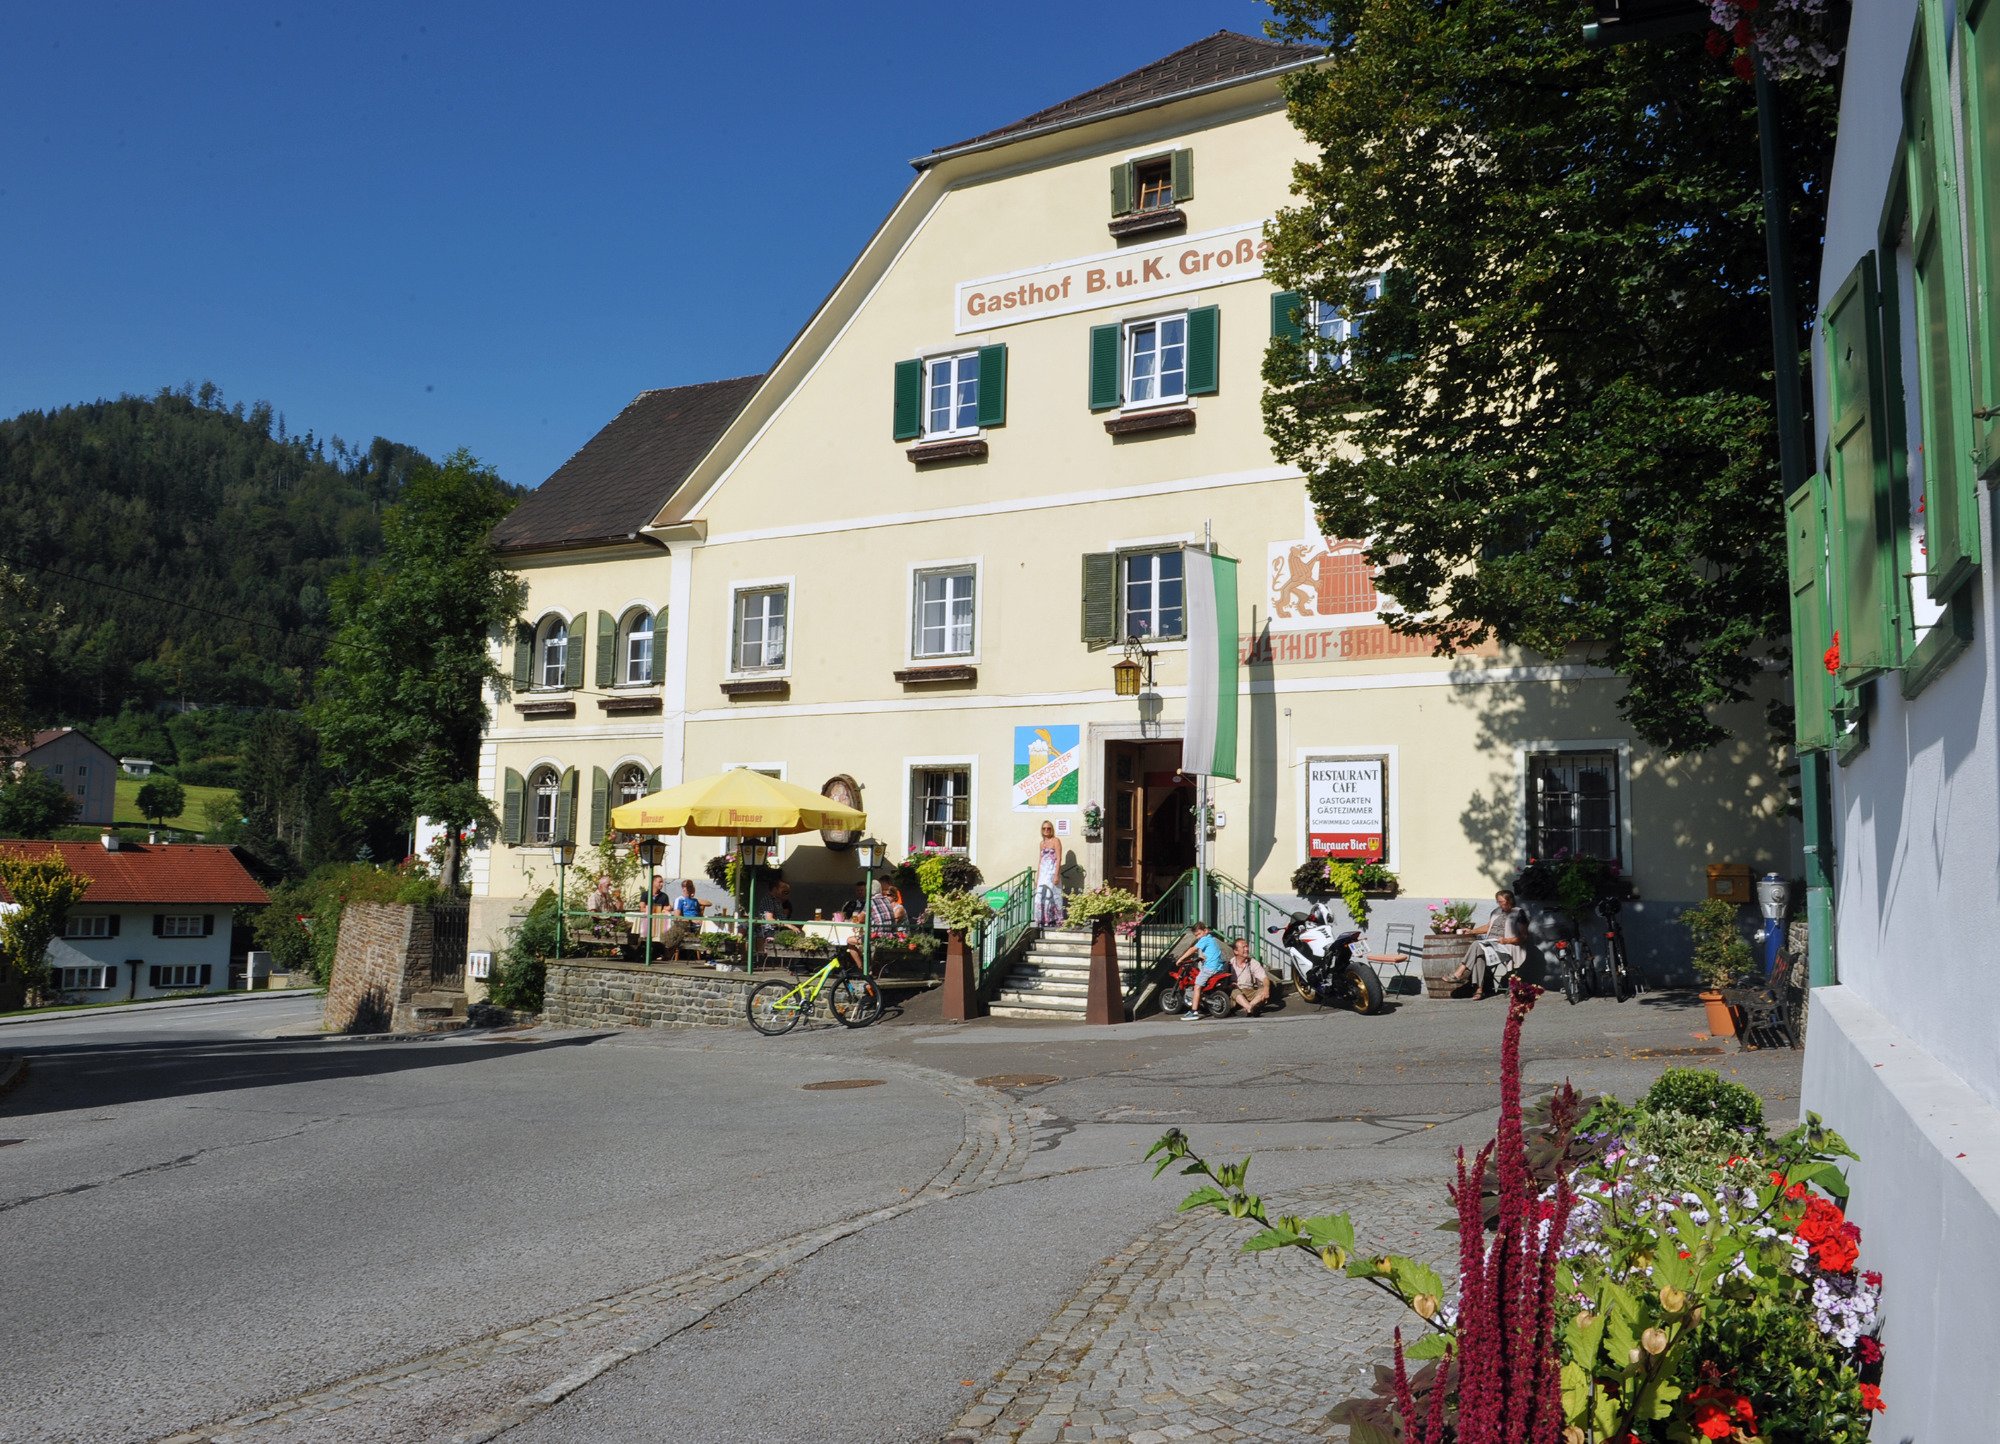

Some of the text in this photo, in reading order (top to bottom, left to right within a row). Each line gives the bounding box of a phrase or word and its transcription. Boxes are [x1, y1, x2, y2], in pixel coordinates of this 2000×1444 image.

[967, 275, 1072, 317] Gasthof
[1178, 238, 1275, 275] Großa
[1025, 765, 1069, 797] BIERKRUG
[1312, 769, 1378, 781] RESTAURANT
[1332, 782, 1357, 793] CAFE
[1317, 806, 1373, 814] GÄSTEZIMMER
[1312, 838, 1367, 851] Murauer Bier
